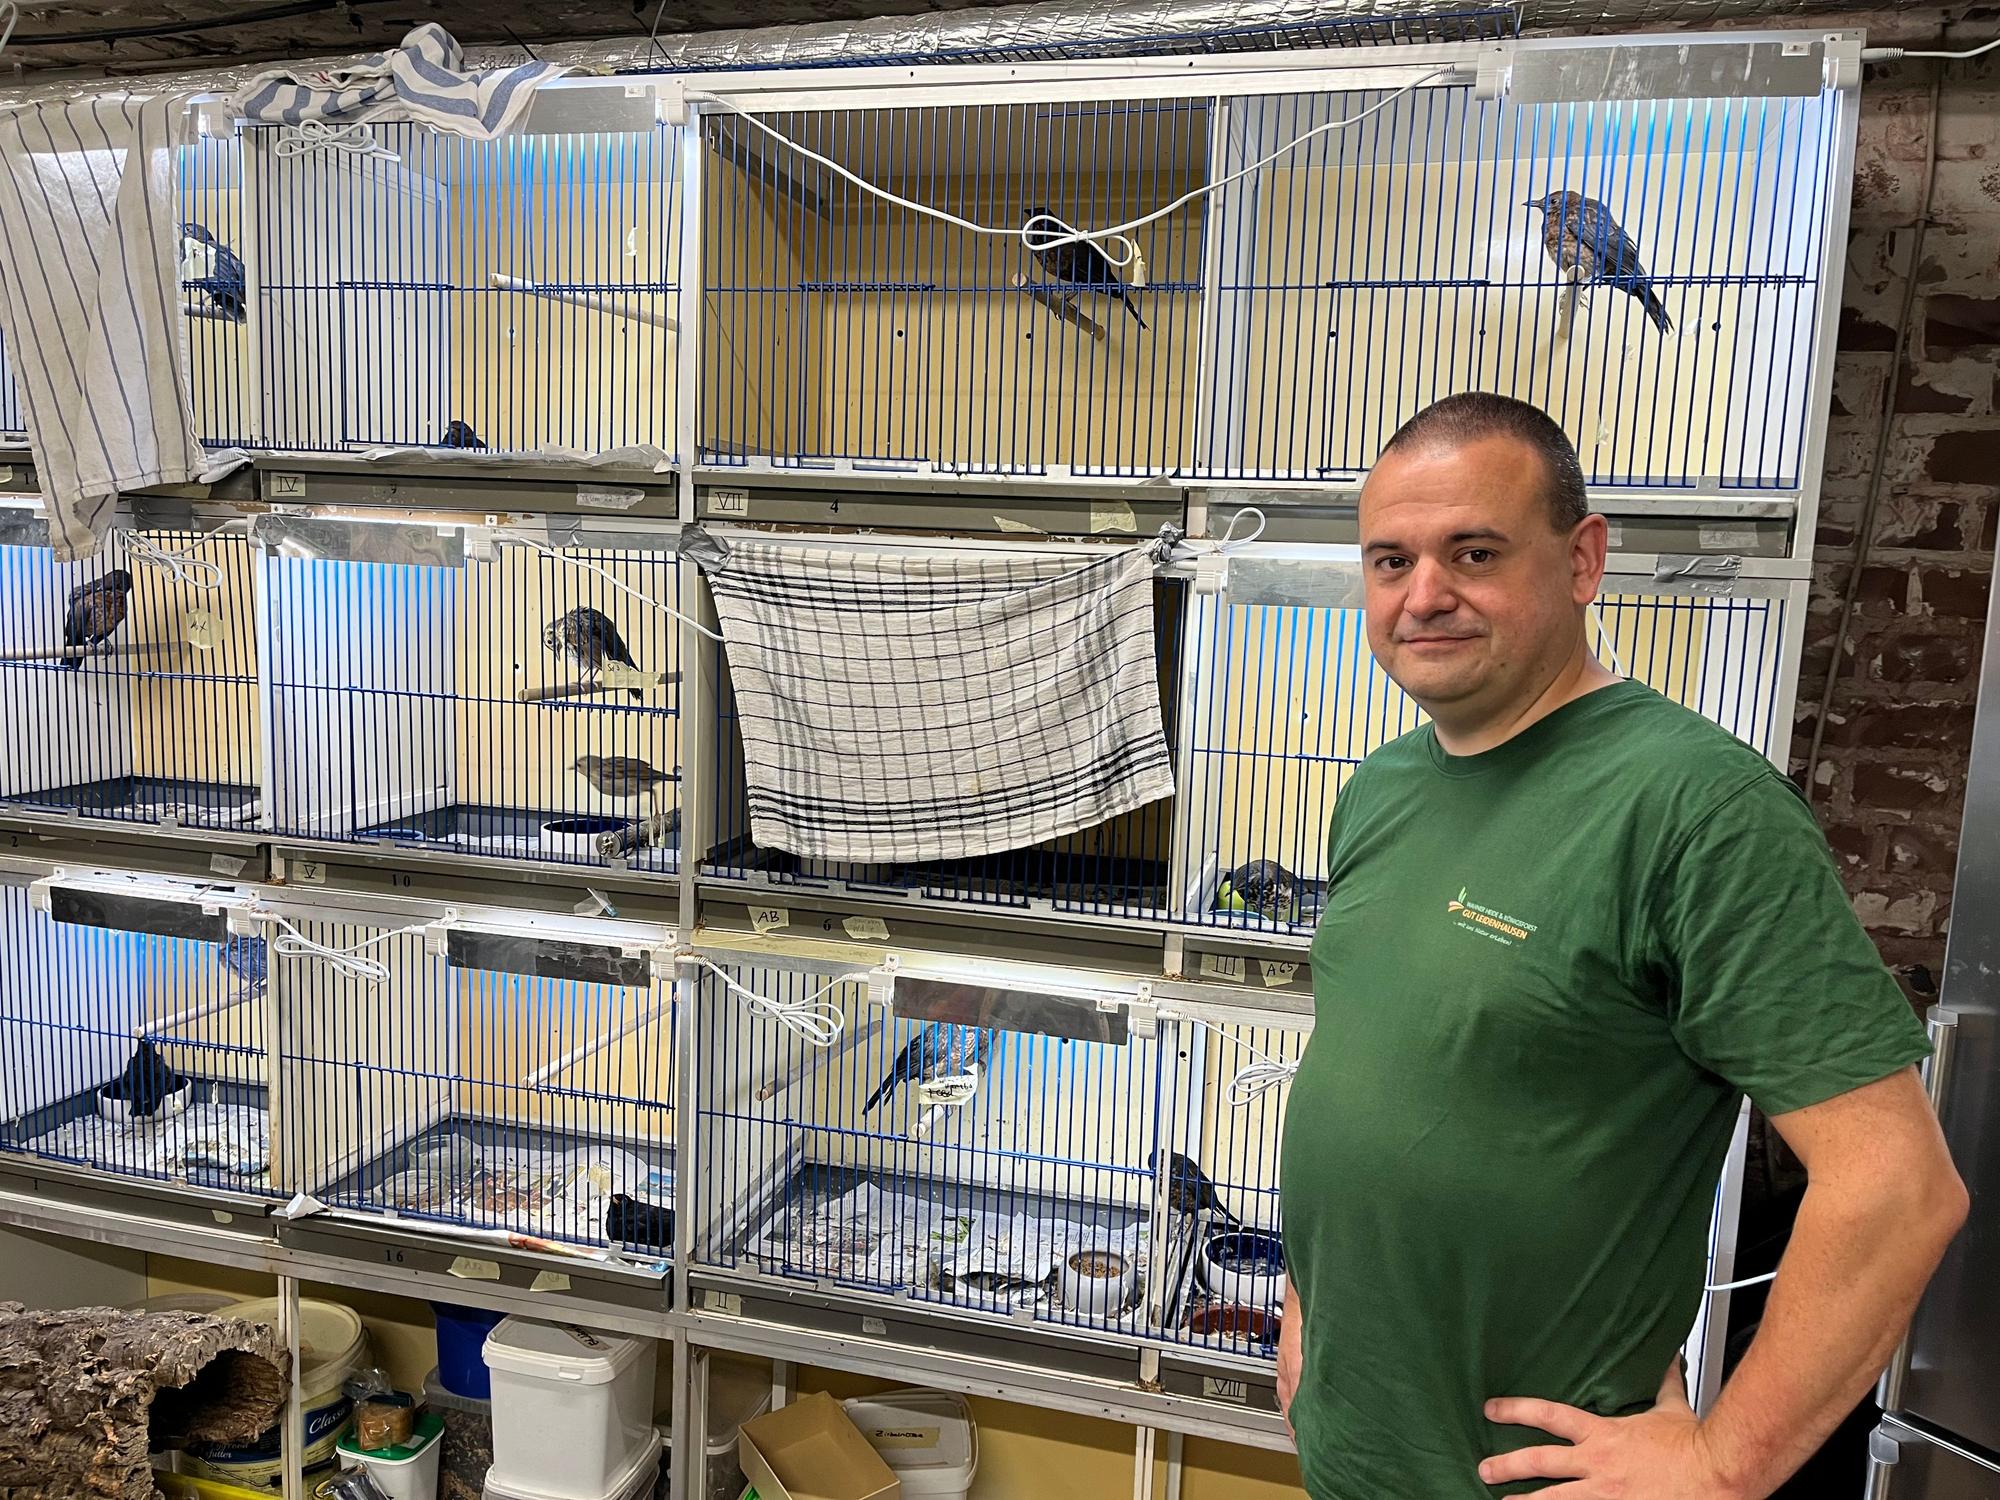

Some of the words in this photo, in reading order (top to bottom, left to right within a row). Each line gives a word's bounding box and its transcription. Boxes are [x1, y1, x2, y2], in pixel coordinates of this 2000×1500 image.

[277, 475, 298, 493] IV
[714, 492, 743, 511] VII
[830, 498, 839, 513] 4
[11, 835, 18, 847] 2
[304, 863, 317, 879] V
[392, 874, 410, 887] 10
[758, 910, 780, 924] AB
[823, 918, 832, 931] 6
[1462, 908, 1476, 920] GUT
[1475, 913, 1528, 940] LEIDENHAUSEN
[1211, 955, 1237, 976] III
[385, 1249, 404, 1263] 16
[716, 1291, 728, 1309] II
[1210, 1378, 1245, 1398] VIII
